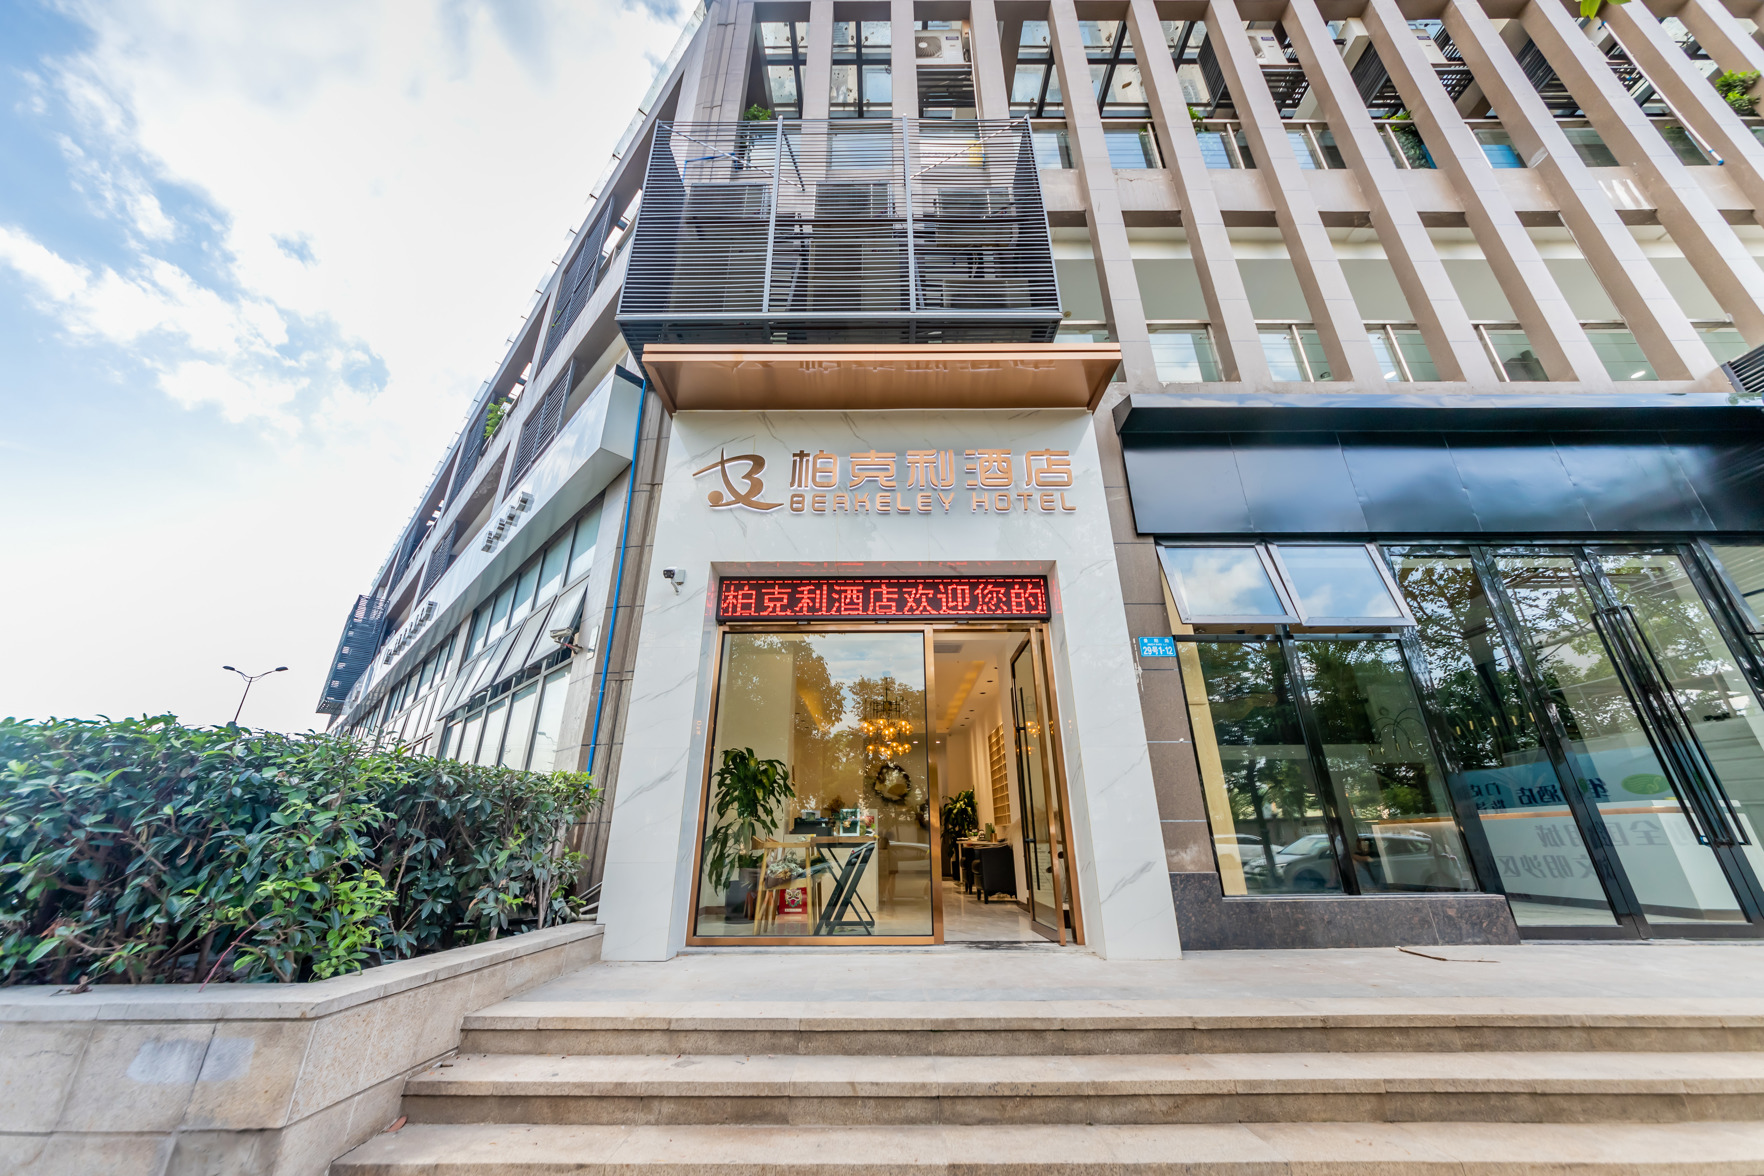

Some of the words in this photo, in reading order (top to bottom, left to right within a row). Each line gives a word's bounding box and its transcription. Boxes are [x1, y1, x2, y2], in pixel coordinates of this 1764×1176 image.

[789, 448, 1074, 489] 柏克利酒店
[971, 492, 1077, 511] HOTEL
[721, 583, 1043, 615] 柏克利酒店欢迎您的
